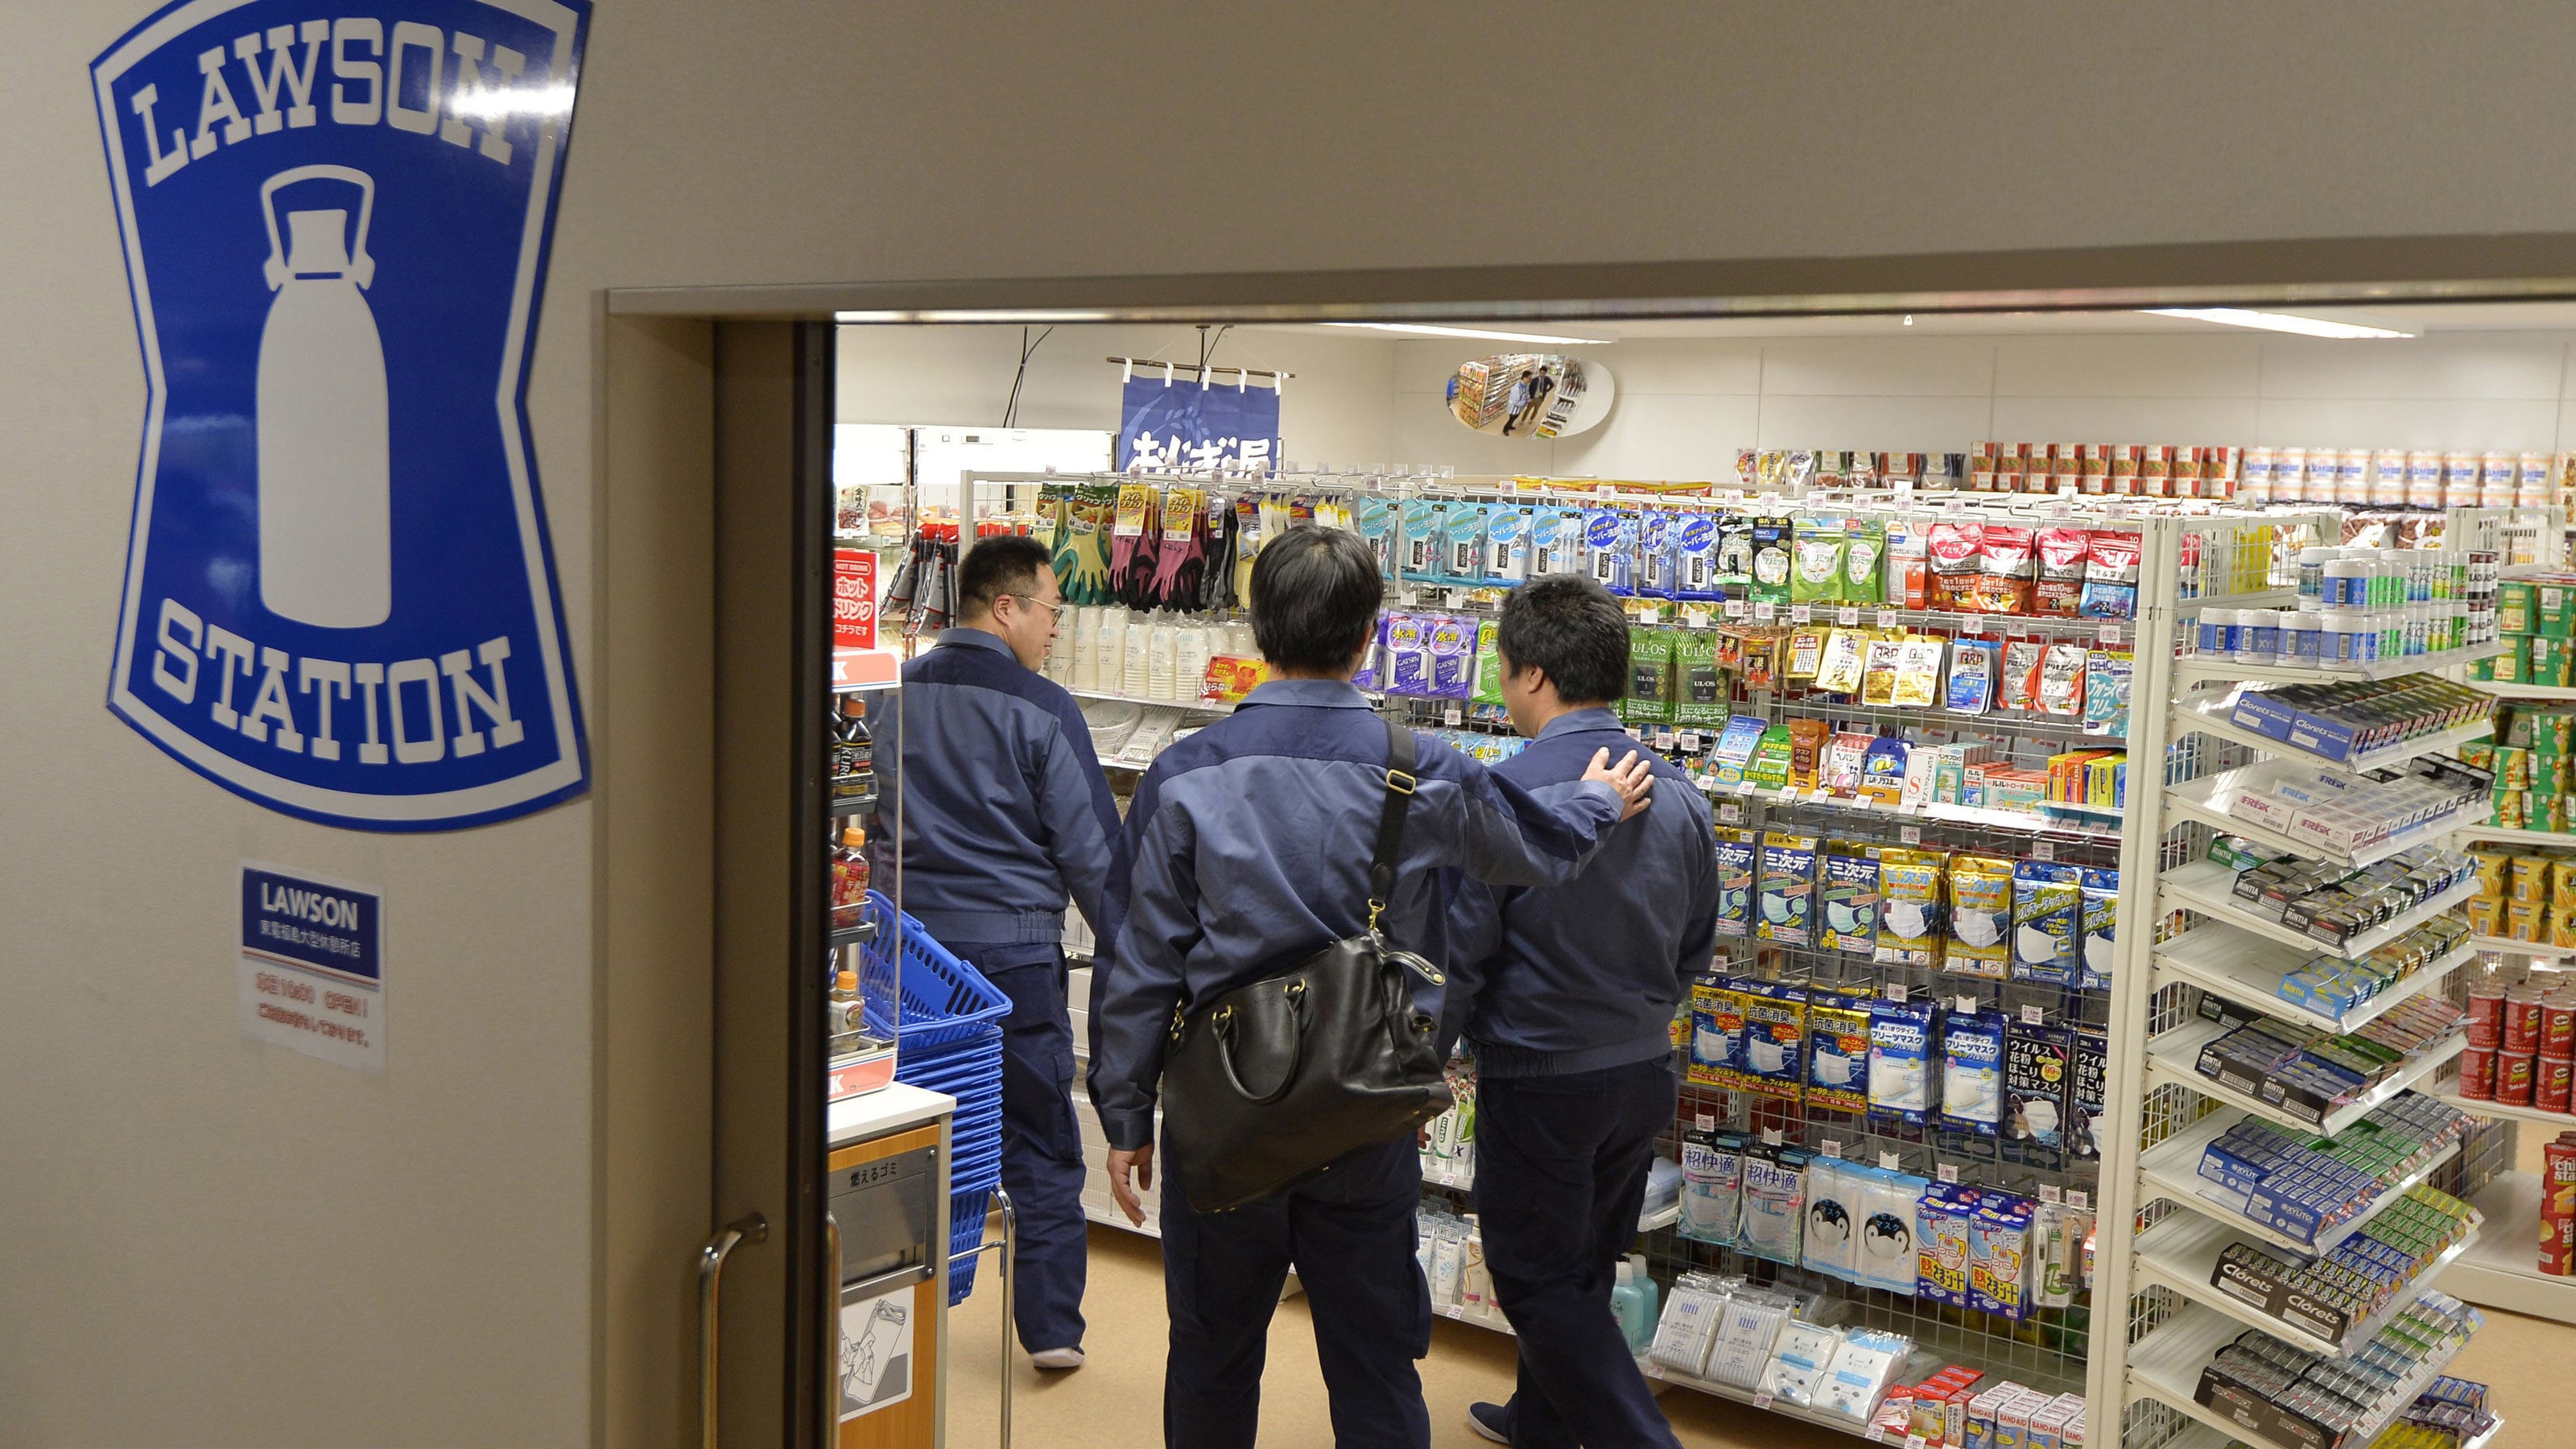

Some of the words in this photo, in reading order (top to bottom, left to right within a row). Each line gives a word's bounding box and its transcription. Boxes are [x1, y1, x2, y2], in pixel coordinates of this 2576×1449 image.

[131, 18, 526, 188] LAWSON
[836, 576, 869, 599] ホット
[835, 624, 869, 637] コチラです
[2089, 661, 2114, 671] DHC
[152, 597, 525, 765] STATION
[2089, 679, 2119, 697] フォース
[1680, 707, 1728, 716] 気になるにおい
[2088, 699, 2113, 716] コリー
[2240, 698, 2270, 715] Clorets
[2296, 719, 2328, 736] Clorets
[1909, 776, 1922, 795] S
[2319, 774, 2347, 791] FRISK
[2281, 786, 2310, 803] FRISK
[2241, 795, 2270, 813] FRISK
[2301, 818, 2332, 836] FRISK
[1765, 851, 1810, 870] 三次元
[2211, 846, 2232, 861] MINTIA
[1830, 860, 1877, 879] 三次元
[1885, 869, 1931, 885] 三次元
[2236, 881, 2259, 897] MINTIA
[262, 882, 357, 931] LAWSON
[2285, 910, 2309, 926] MINTIA
[2282, 982, 2305, 998] MINTIA
[1872, 1030, 1922, 1044] プリーツマスク
[1946, 1039, 1996, 1054] プリーツマスク
[2011, 1040, 2051, 1056] ウイルス
[2009, 1051, 2031, 1065] 花粉
[2202, 1053, 2223, 1068] MINTIA
[2008, 1063, 2038, 1078] ほこり
[2078, 1064, 2098, 1080] 花粉
[2008, 1075, 2062, 1093] 対策マスク
[2077, 1076, 2104, 1091] ほこり
[2264, 1080, 2285, 1096] MINTIA
[1439, 1117, 1449, 1142] GUM
[1685, 1150, 1737, 1175] 超快適
[850, 1162, 898, 1187] 燃えるゴミ
[1747, 1165, 1799, 1192] 超快適
[1876, 1220, 1900, 1232] マスク
[1921, 1257, 1965, 1291] 熱さまシート
[1974, 1268, 2019, 1304] 熱さまシート
